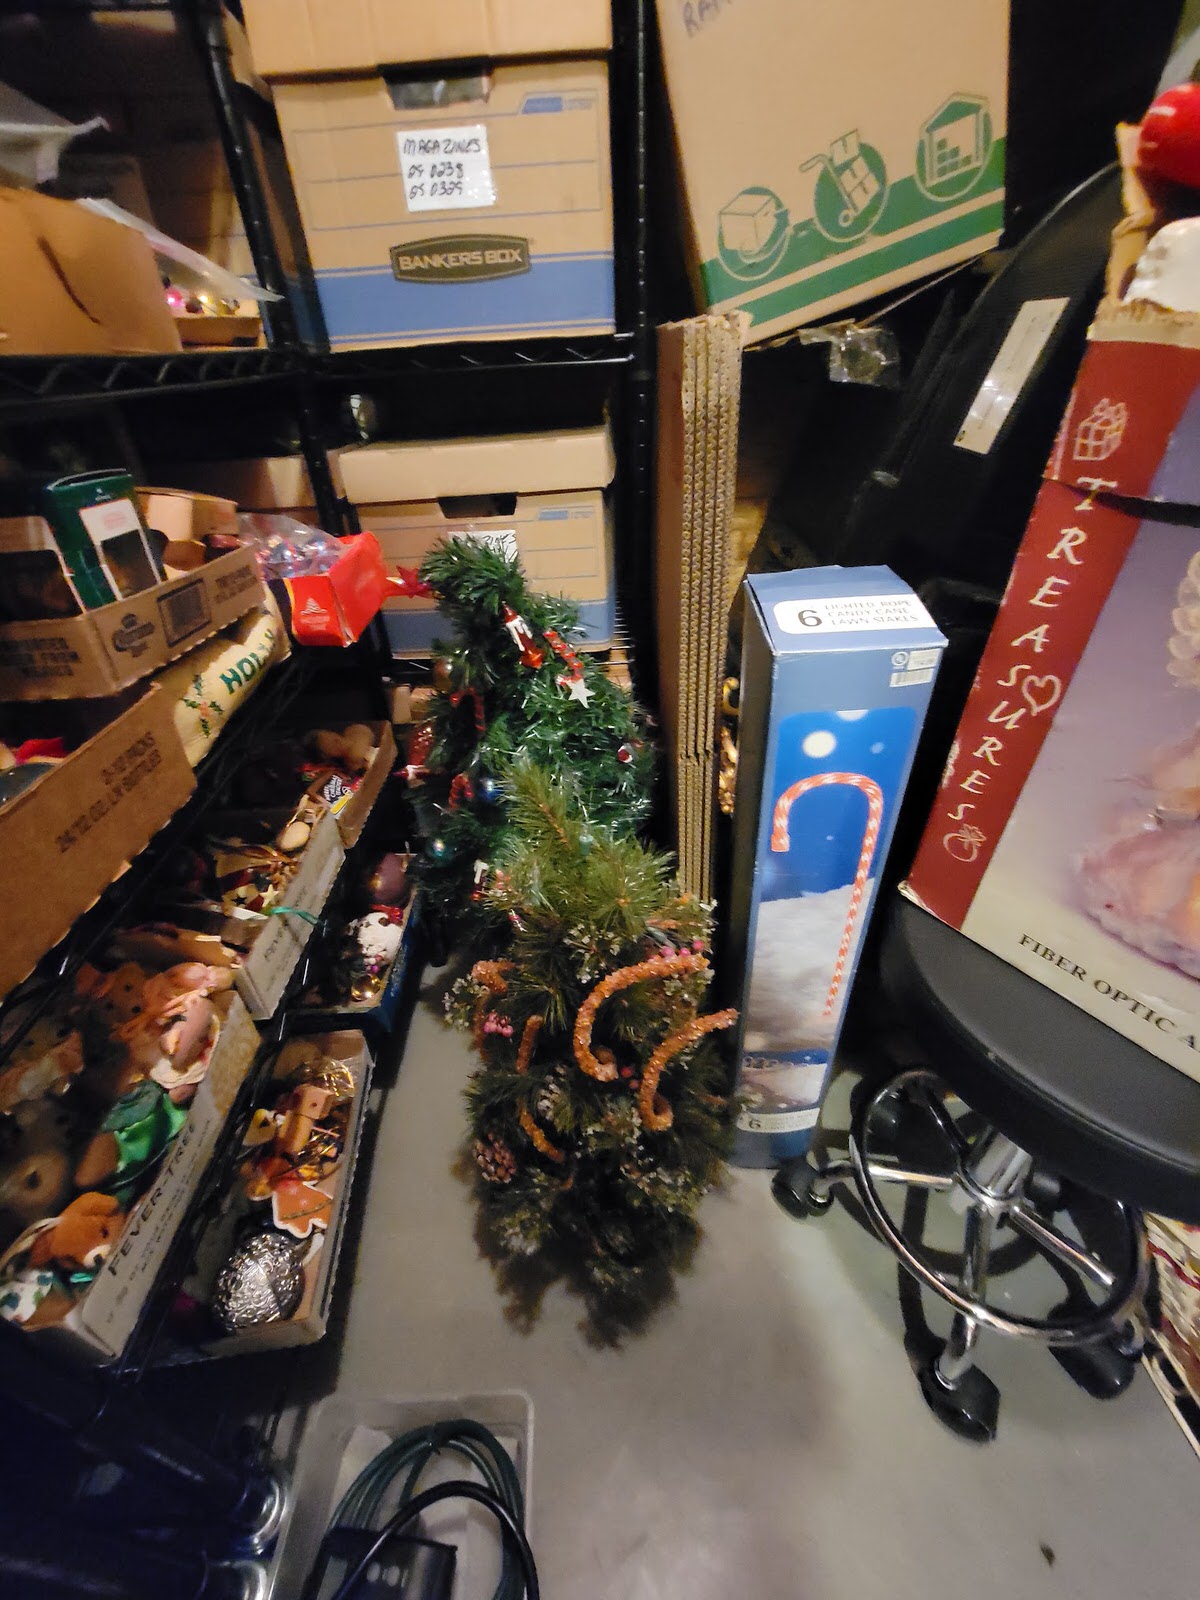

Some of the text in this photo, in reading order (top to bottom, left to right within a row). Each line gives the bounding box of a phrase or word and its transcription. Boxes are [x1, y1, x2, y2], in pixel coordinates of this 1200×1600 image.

[399, 249, 523, 270] BANKERS BOX
[824, 602, 875, 610] LIGHTED
[827, 609, 871, 617] CANDY
[797, 609, 823, 627] 6
[873, 615, 919, 623] STAKES
[948, 476, 1118, 821] TREASURES
[1018, 933, 1200, 1053] FIBER OPTIC A
